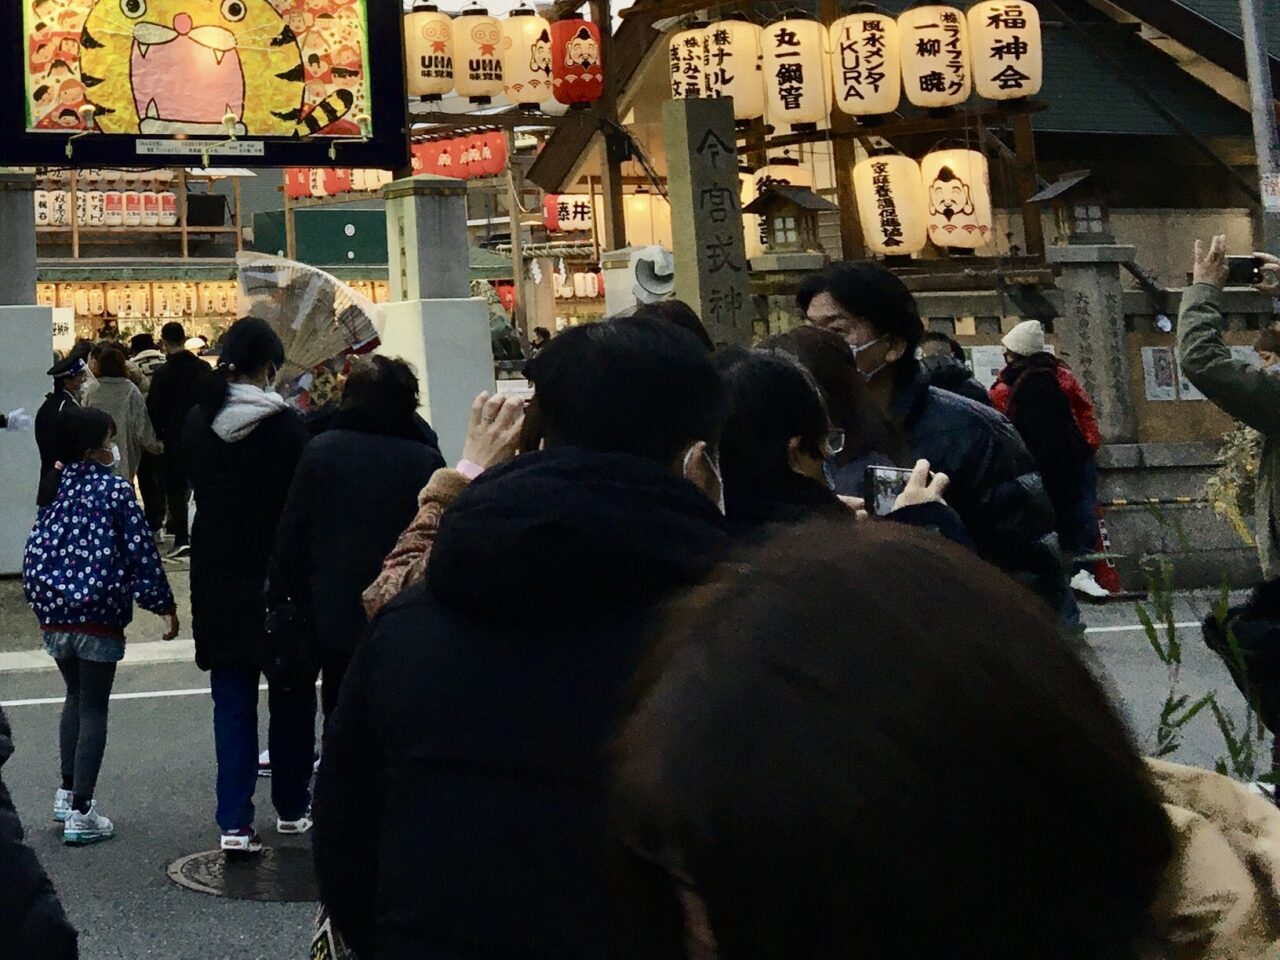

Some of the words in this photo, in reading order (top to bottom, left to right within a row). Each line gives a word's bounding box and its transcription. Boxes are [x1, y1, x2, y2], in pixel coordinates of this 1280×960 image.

[421, 55, 453, 69] UHA
[469, 58, 503, 72] UHA
[774, 27, 804, 111] 丸一鋼管
[839, 27, 865, 101] IKURA
[862, 19, 886, 93] 風水メンター
[985, 4, 1031, 91] 福神会
